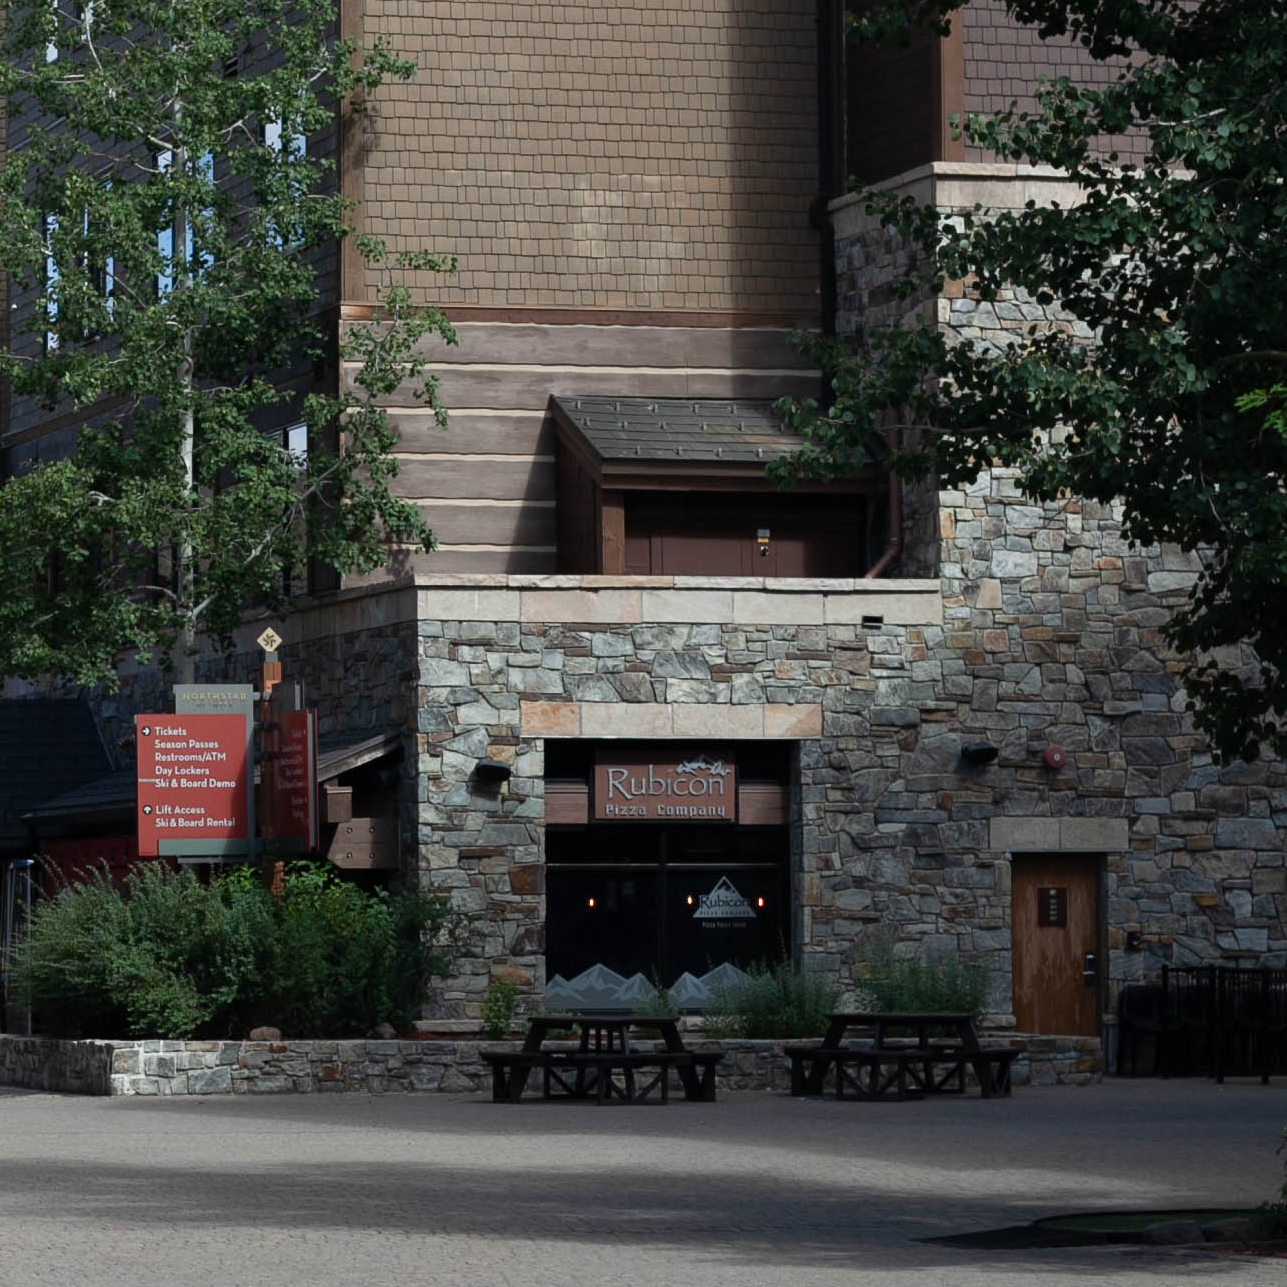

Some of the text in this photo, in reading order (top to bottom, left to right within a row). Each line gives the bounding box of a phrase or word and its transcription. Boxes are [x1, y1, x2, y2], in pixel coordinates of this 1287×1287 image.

[154, 726, 187, 736] Tickets
[154, 739, 219, 749] Season Passes
[155, 752, 227, 762] Restrooms/ATM
[155, 766, 210, 777] Day Lockers
[155, 778, 236, 788] Ski & Board Demo
[607, 764, 725, 800] Rubicon
[155, 805, 206, 815] Lift Access
[605, 804, 726, 819] Pizza Company
[155, 818, 236, 828] Ski & Board Rental
